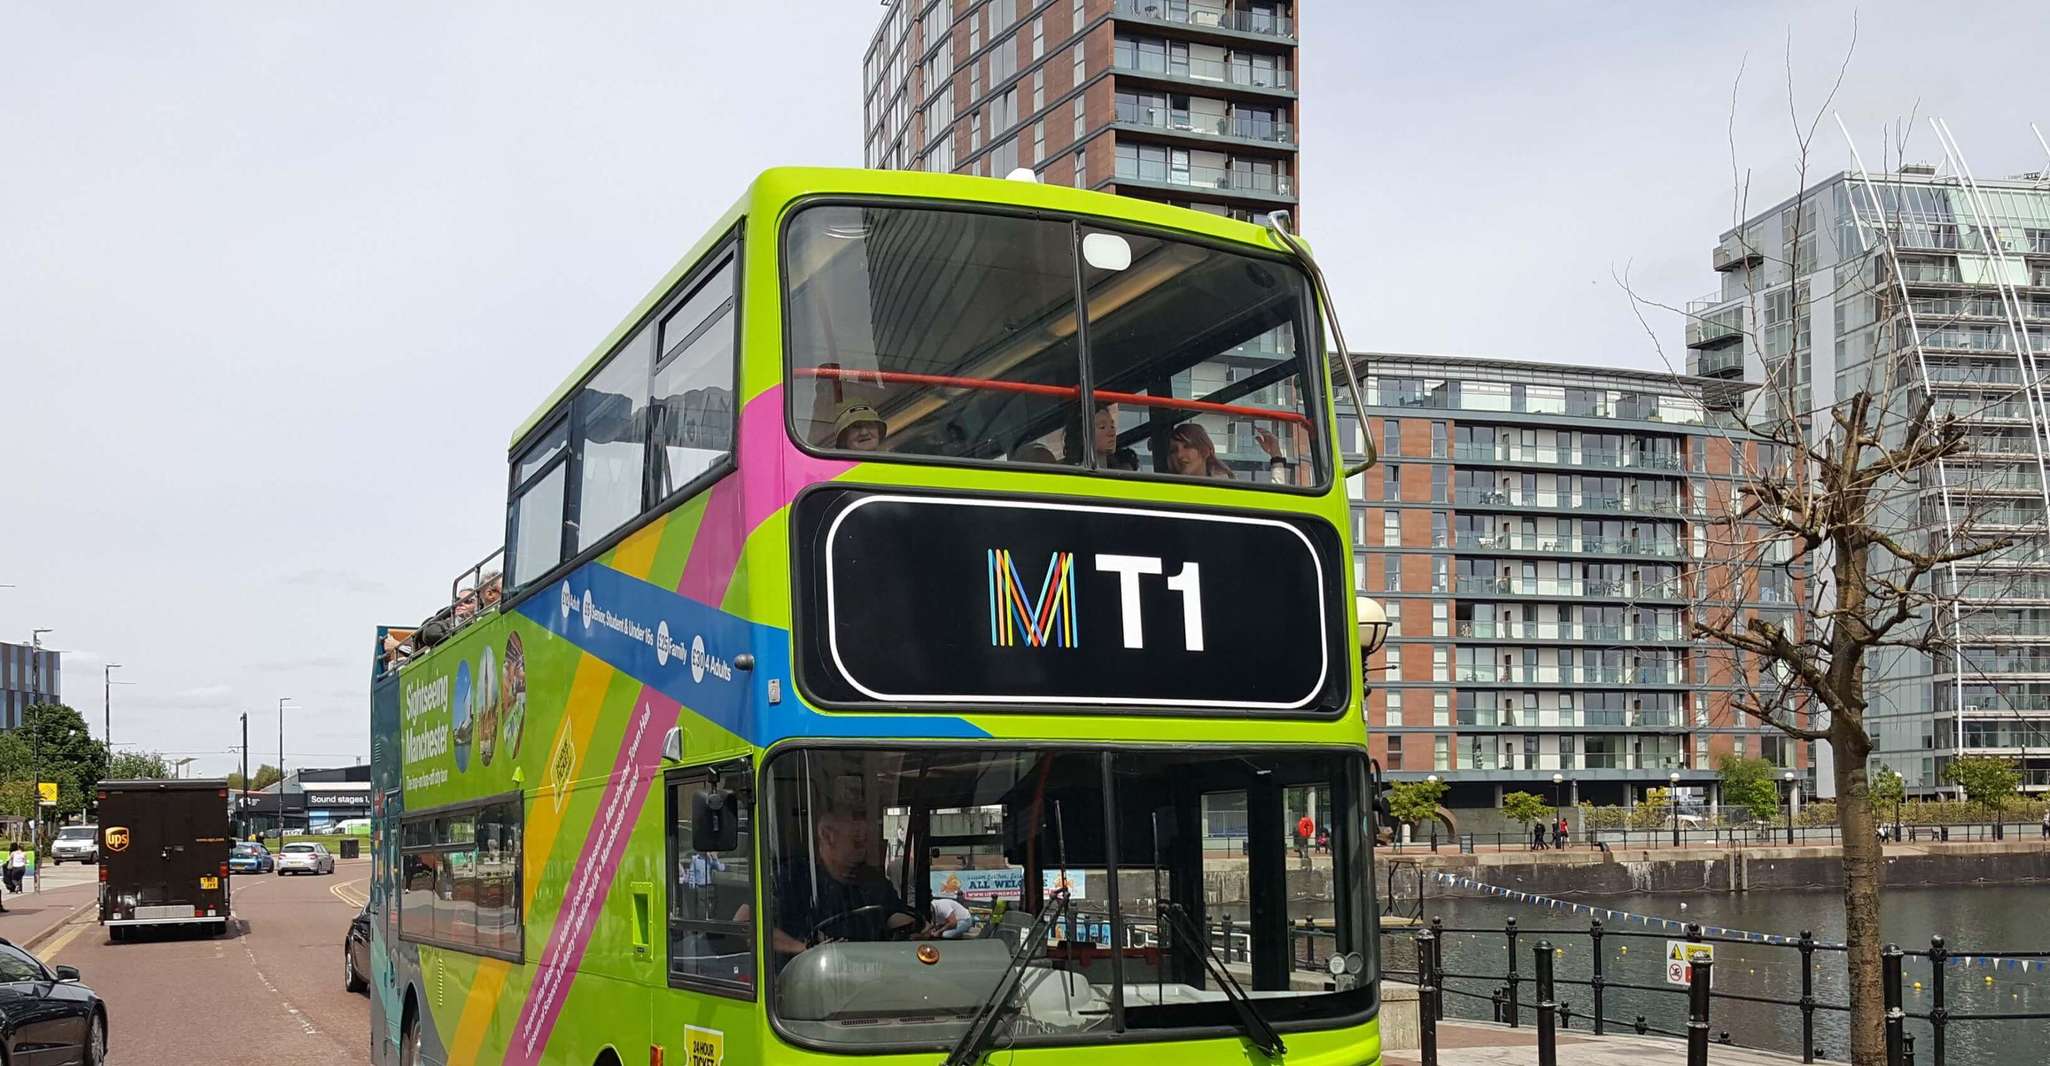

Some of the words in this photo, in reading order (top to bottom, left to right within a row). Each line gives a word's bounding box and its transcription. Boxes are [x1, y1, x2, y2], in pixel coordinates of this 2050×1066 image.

[1094, 552, 1206, 652] T1
[606, 609, 624, 633] Student
[624, 617, 629, 635] &
[628, 619, 645, 642] Under
[645, 627, 654, 646] 16s
[668, 637, 688, 665] Family
[710, 656, 732, 681] Adults
[406, 674, 448, 726] Sightseeing
[406, 722, 448, 765] Manchester
[338, 796, 363, 805] stages
[108, 834, 128, 848] ups
[543, 943, 559, 989] Museum
[559, 902, 575, 947] National
[586, 824, 604, 876] Museum
[605, 756, 631, 826] Manchester
[628, 725, 642, 763] Town
[639, 700, 651, 734] Hall
[969, 880, 990, 889] ALL
[527, 1016, 541, 1055] Museum
[543, 973, 559, 1017] Science
[559, 934, 575, 979] Industry
[600, 799, 626, 870] Manchester
[623, 763, 640, 810] United
[693, 1040, 700, 1054] 24
[700, 1041, 715, 1056] HOUR
